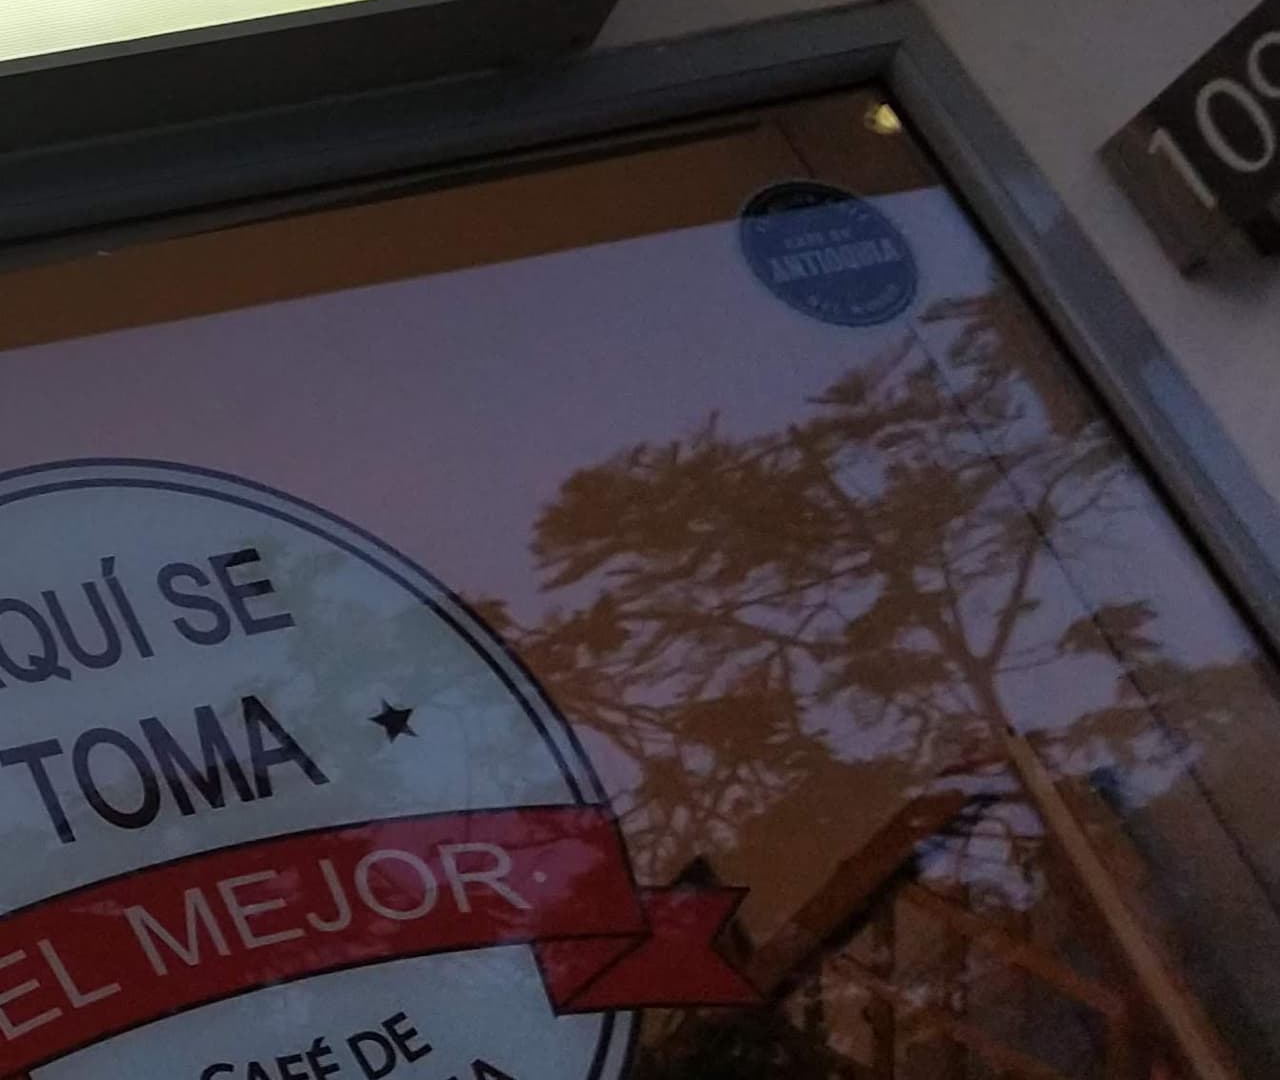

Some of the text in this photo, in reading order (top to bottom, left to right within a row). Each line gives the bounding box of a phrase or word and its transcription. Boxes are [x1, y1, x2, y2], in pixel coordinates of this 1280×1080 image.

[156, 547, 295, 646] SE
[122, 842, 531, 976] MEJOR
[345, 1011, 433, 1080] DE
